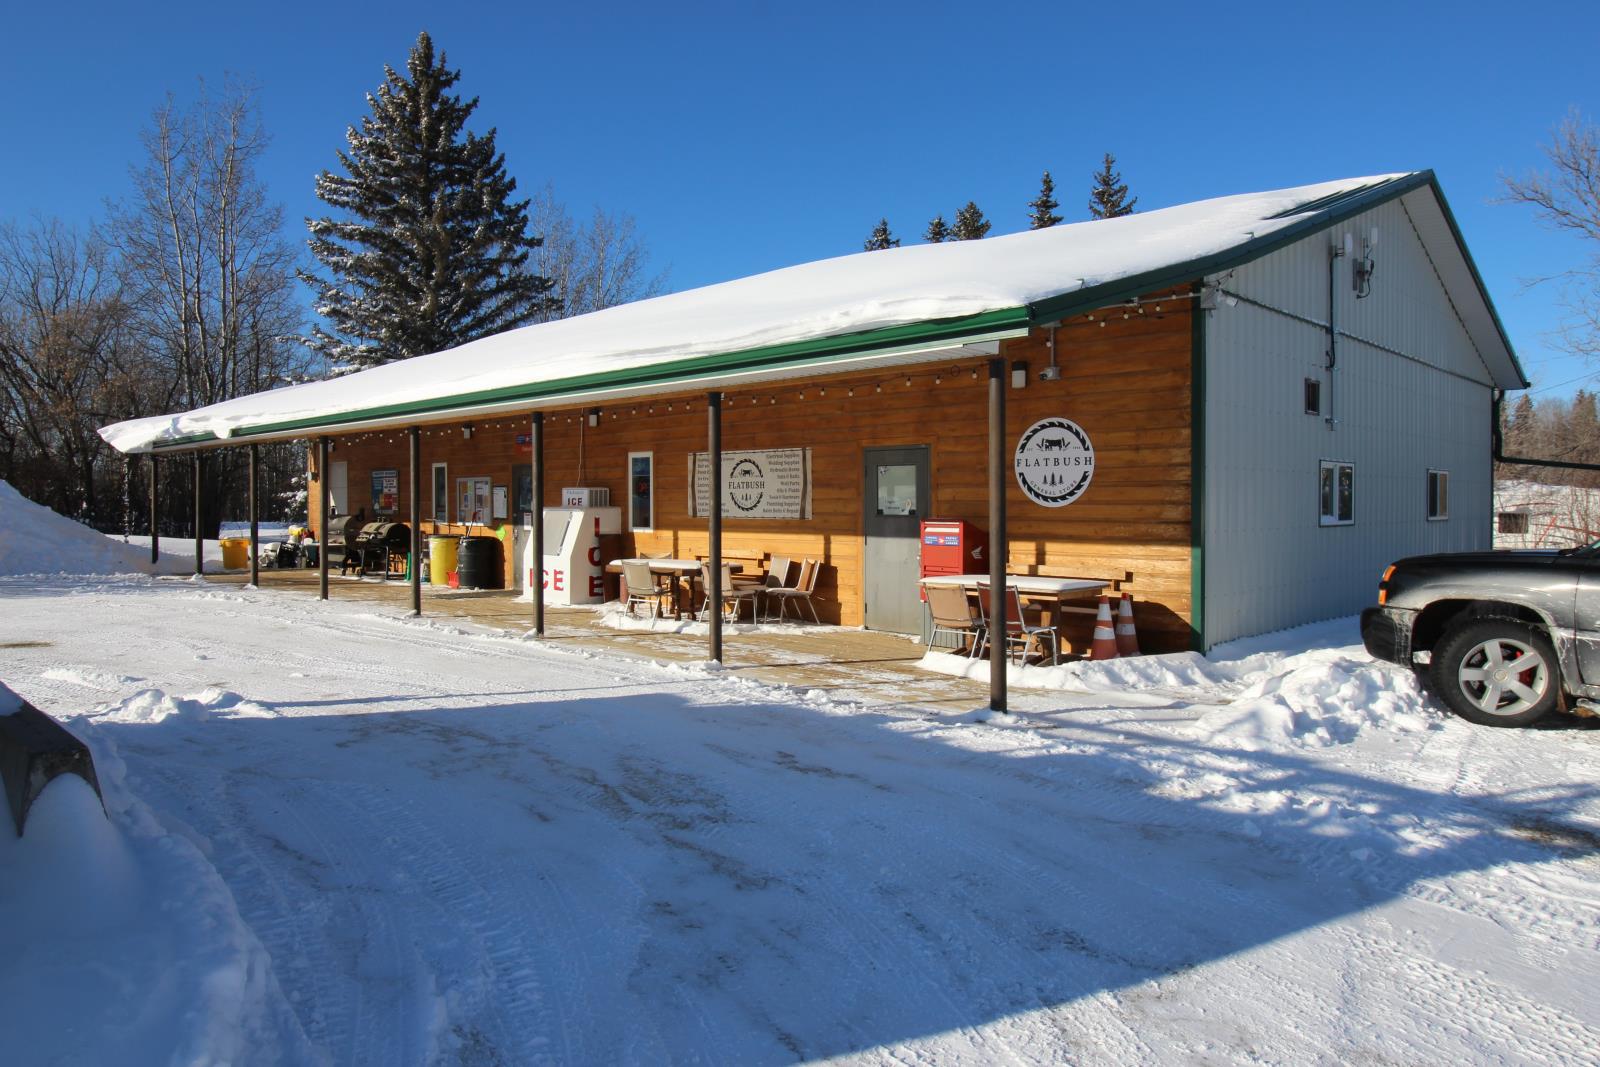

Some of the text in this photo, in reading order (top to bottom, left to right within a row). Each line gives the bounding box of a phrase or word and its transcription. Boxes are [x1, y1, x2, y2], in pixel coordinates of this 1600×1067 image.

[1016, 456, 1092, 468] FLATBUSH
[728, 480, 765, 490] FLATBUSH
[1030, 480, 1078, 496] GENERAL STORE
[567, 497, 583, 507] ICE
[588, 517, 603, 597] ICE
